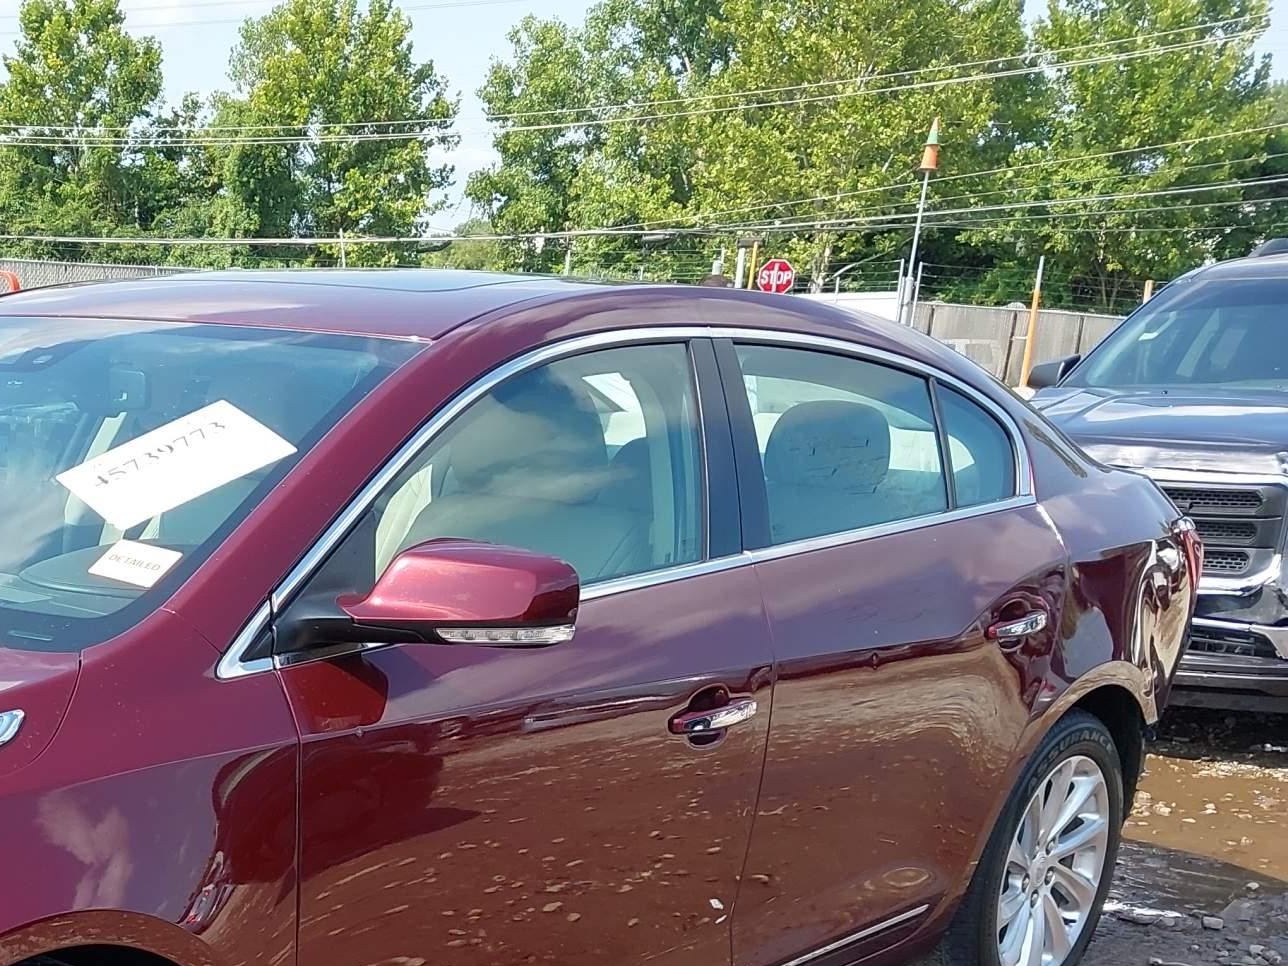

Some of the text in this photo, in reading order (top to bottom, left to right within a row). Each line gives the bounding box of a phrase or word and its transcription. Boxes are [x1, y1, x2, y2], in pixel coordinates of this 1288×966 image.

[760, 270, 793, 285] STOP
[109, 554, 161, 571] DETAILED
[1026, 729, 1114, 797] ASSURANCE
